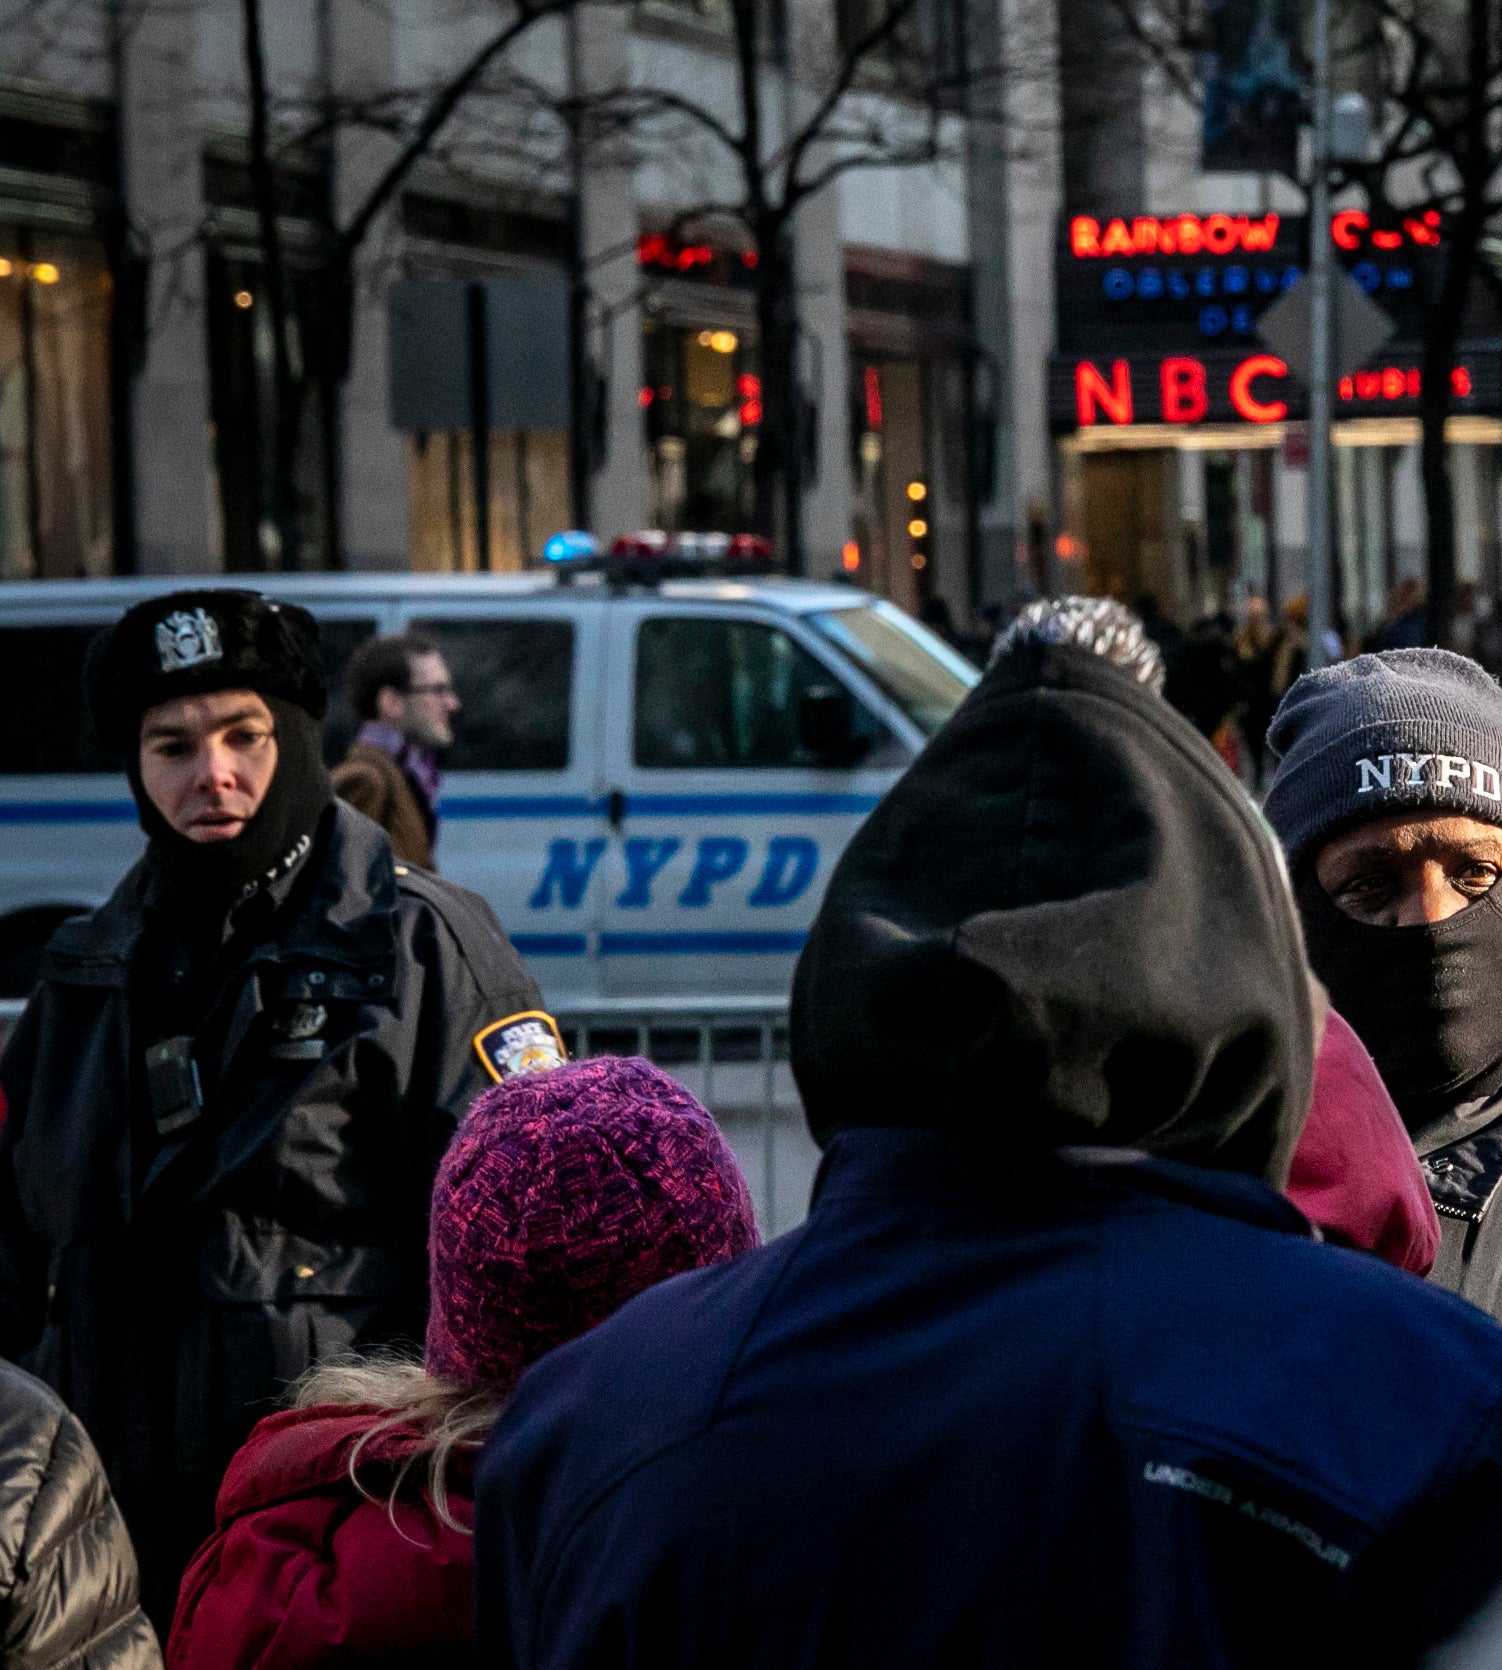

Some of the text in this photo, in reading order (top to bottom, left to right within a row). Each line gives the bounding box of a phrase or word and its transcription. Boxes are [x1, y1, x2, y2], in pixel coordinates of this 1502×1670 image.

[1069, 213, 1280, 259] RAINBOW
[1356, 752, 1501, 801] NYPD
[530, 836, 819, 908] NYPD
